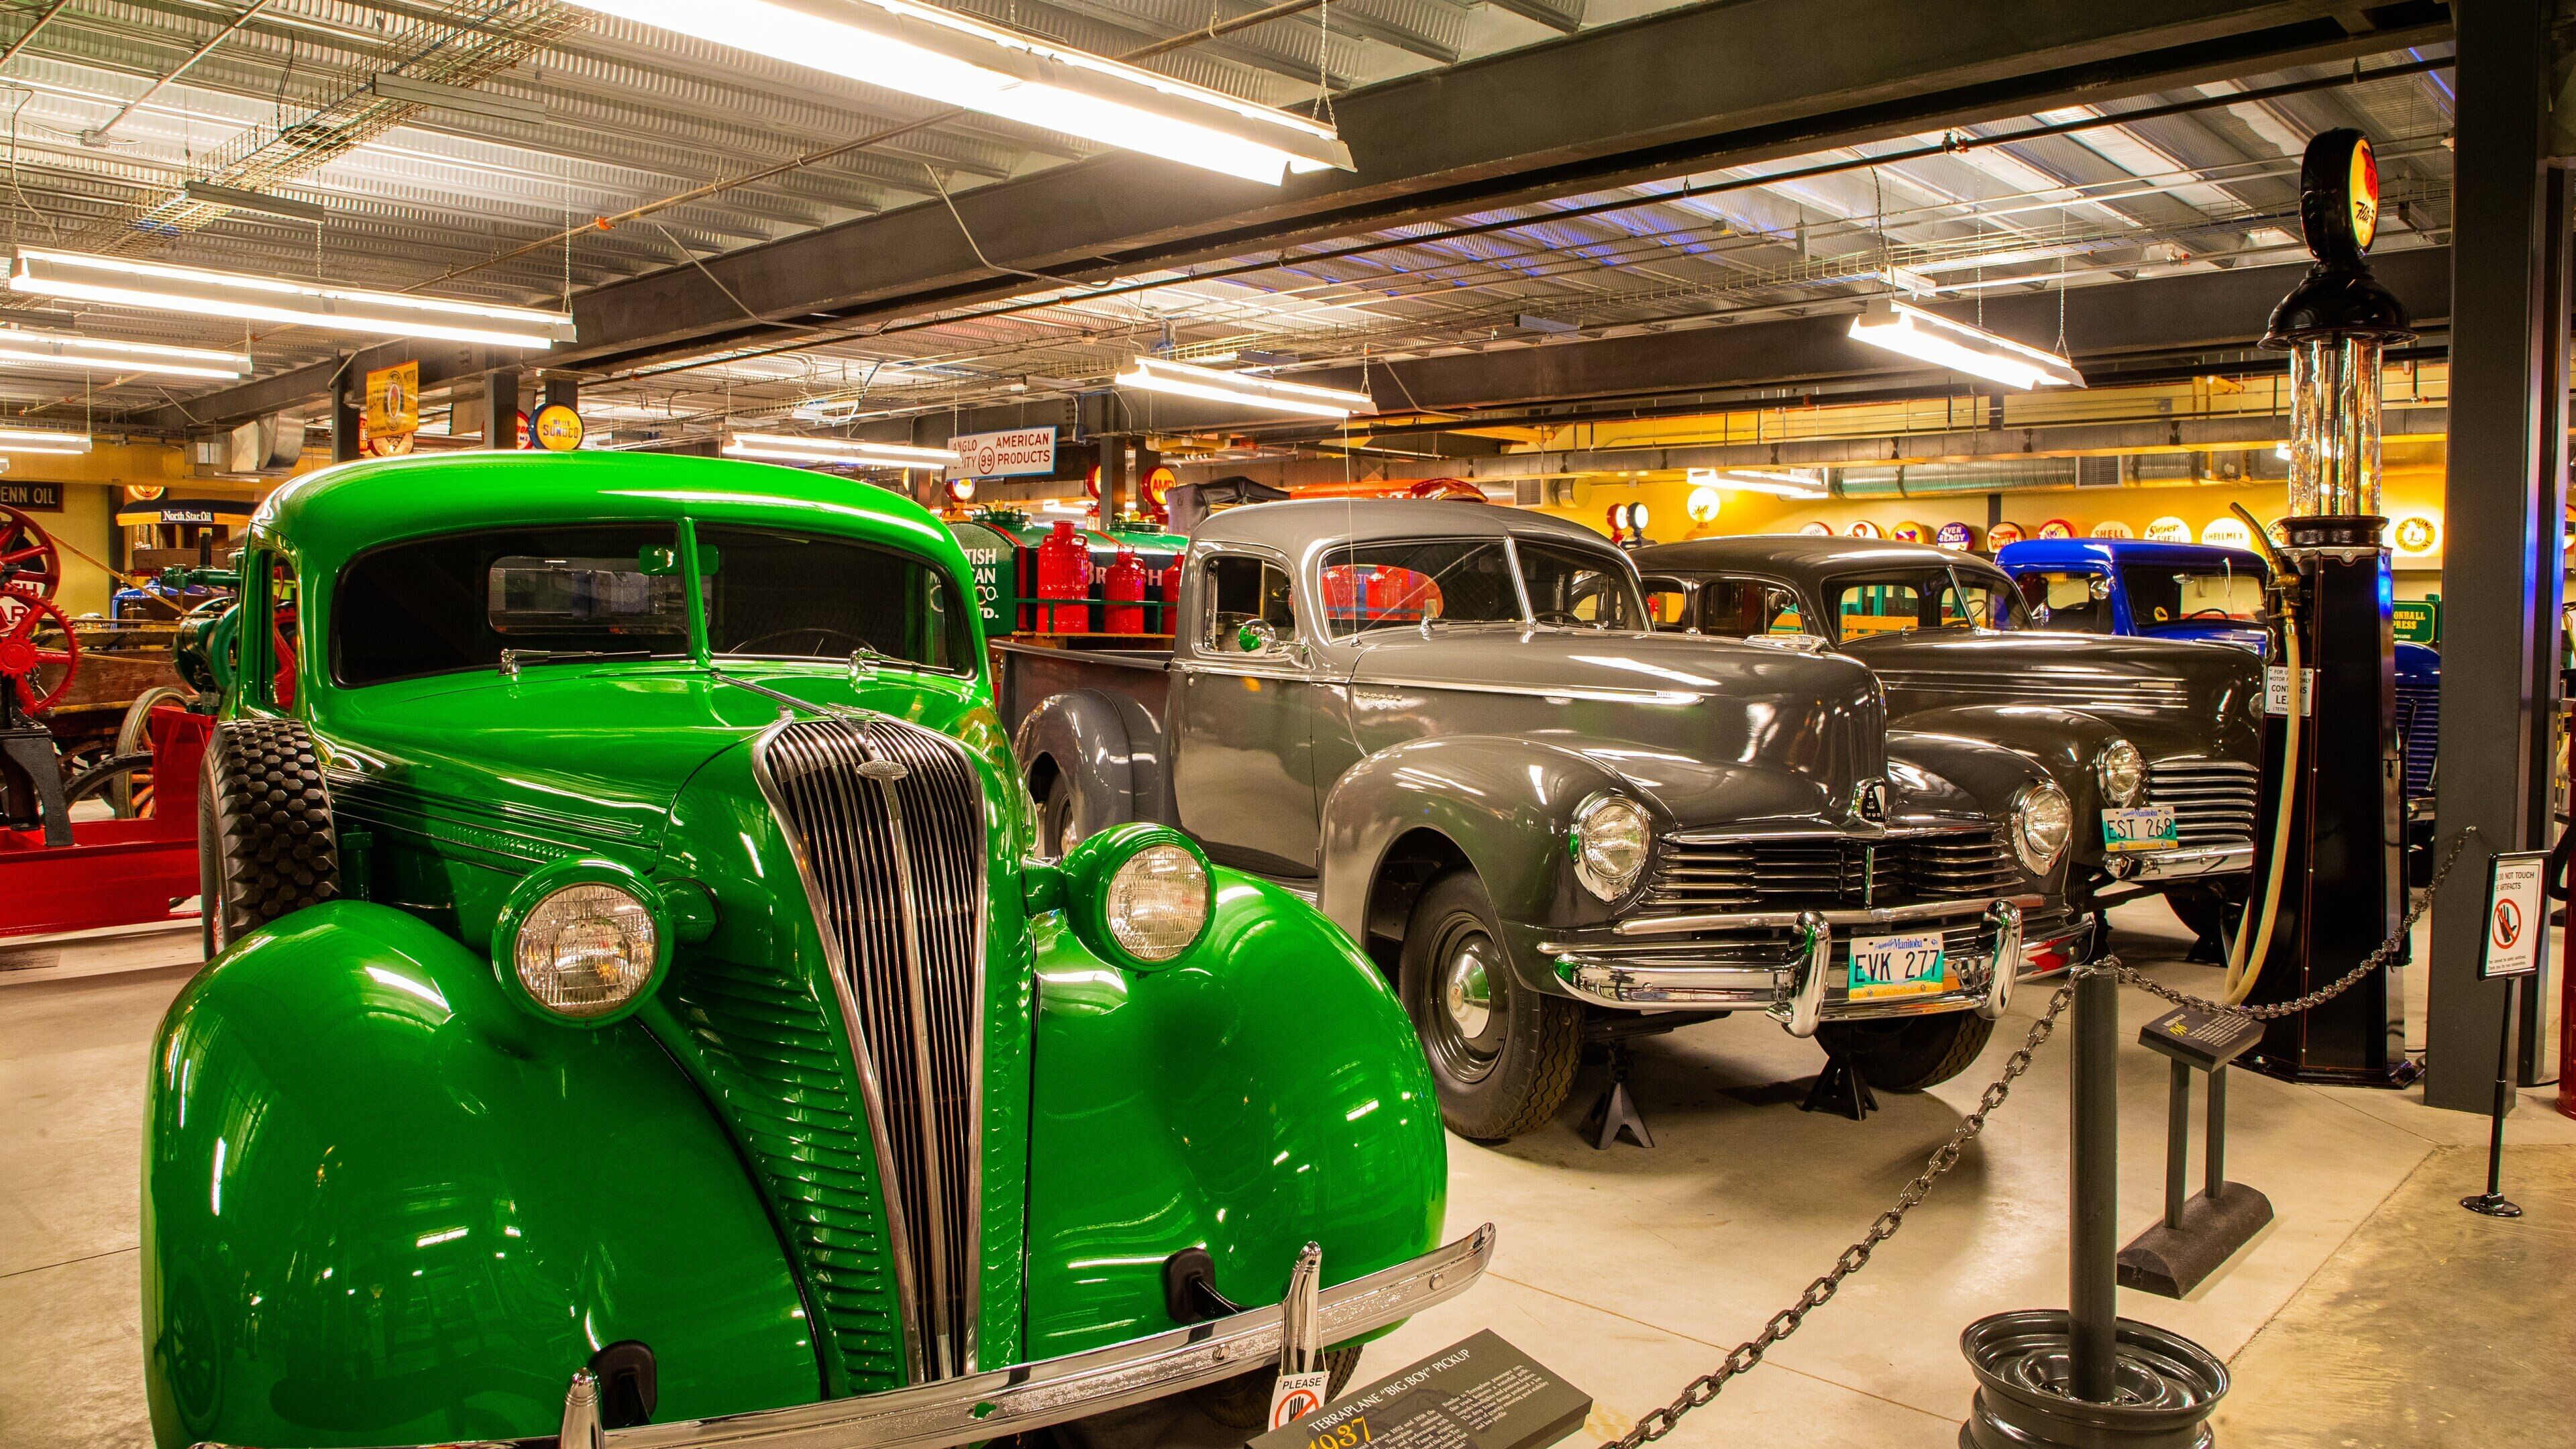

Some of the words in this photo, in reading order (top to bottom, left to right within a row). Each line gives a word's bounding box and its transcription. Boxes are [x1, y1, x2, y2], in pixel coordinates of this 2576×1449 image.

[543, 425, 578, 438] SUNOCO
[953, 439, 977, 453] ANGLO
[996, 433, 1049, 449] AMERICAN
[981, 454, 992, 467] 99
[998, 450, 1050, 465] PRODUCTS
[34, 488, 56, 504] OIL
[162, 511, 184, 521] North
[185, 511, 200, 521] Star
[201, 511, 211, 521] Oil
[1692, 504, 1710, 515] Shell
[1939, 534, 1966, 542] READY
[2095, 529, 2125, 538] SHELL
[1992, 538, 2015, 546] POWER
[979, 608, 999, 619] TD.
[2107, 819, 2134, 839] EST
[2146, 818, 2172, 837] 268
[2500, 882, 2522, 891] ARTIFACTS
[1894, 938, 1923, 950] Manitoba
[1854, 952, 1892, 983] EVK
[1904, 949, 1939, 979] 277
[1283, 1377, 1322, 1390] PLEASE
[1308, 1393, 1383, 1432] TERRAPLANE
[1432, 1349, 1470, 1372] PICKUP
[1442, 1397, 1460, 1407] Similar
[1465, 1381, 1491, 1395] Terraplane
[1491, 1370, 1513, 1383] passenger
[1460, 1397, 1473, 1406] truck
[1472, 1389, 1492, 1399] features
[1497, 1375, 1517, 1387] waterfall
[1455, 1406, 1474, 1416] torpedo
[1471, 1394, 1495, 1407] headlights
[1503, 1381, 1520, 1393] pontoon
[1469, 1416, 1483, 1426] centre
[1488, 1405, 1503, 1416] gravity
[1503, 1395, 1523, 1407] ensuring
[1521, 1389, 1532, 1397] good
[1532, 1381, 1549, 1392] stability
[1482, 1401, 1497, 1410] frame
[1496, 1393, 1511, 1403] design
[1511, 1382, 1531, 1395] produced
[1368, 1433, 1391, 1445] between
[1390, 1425, 1404, 1434] 1932
[1404, 1419, 1414, 1428] and
[1385, 1429, 1413, 1444] Terraplane
[1420, 1413, 1442, 1427] combined
[1415, 1434, 1434, 1445] Famed
[1436, 1423, 1456, 1435] aviatrix
[1475, 1422, 1485, 1430] and
[1397, 1439, 1408, 1448] and
[1407, 1425, 1437, 1442] performance
[1440, 1433, 1452, 1441] first
[1440, 1437, 1458, 1449] claimed
